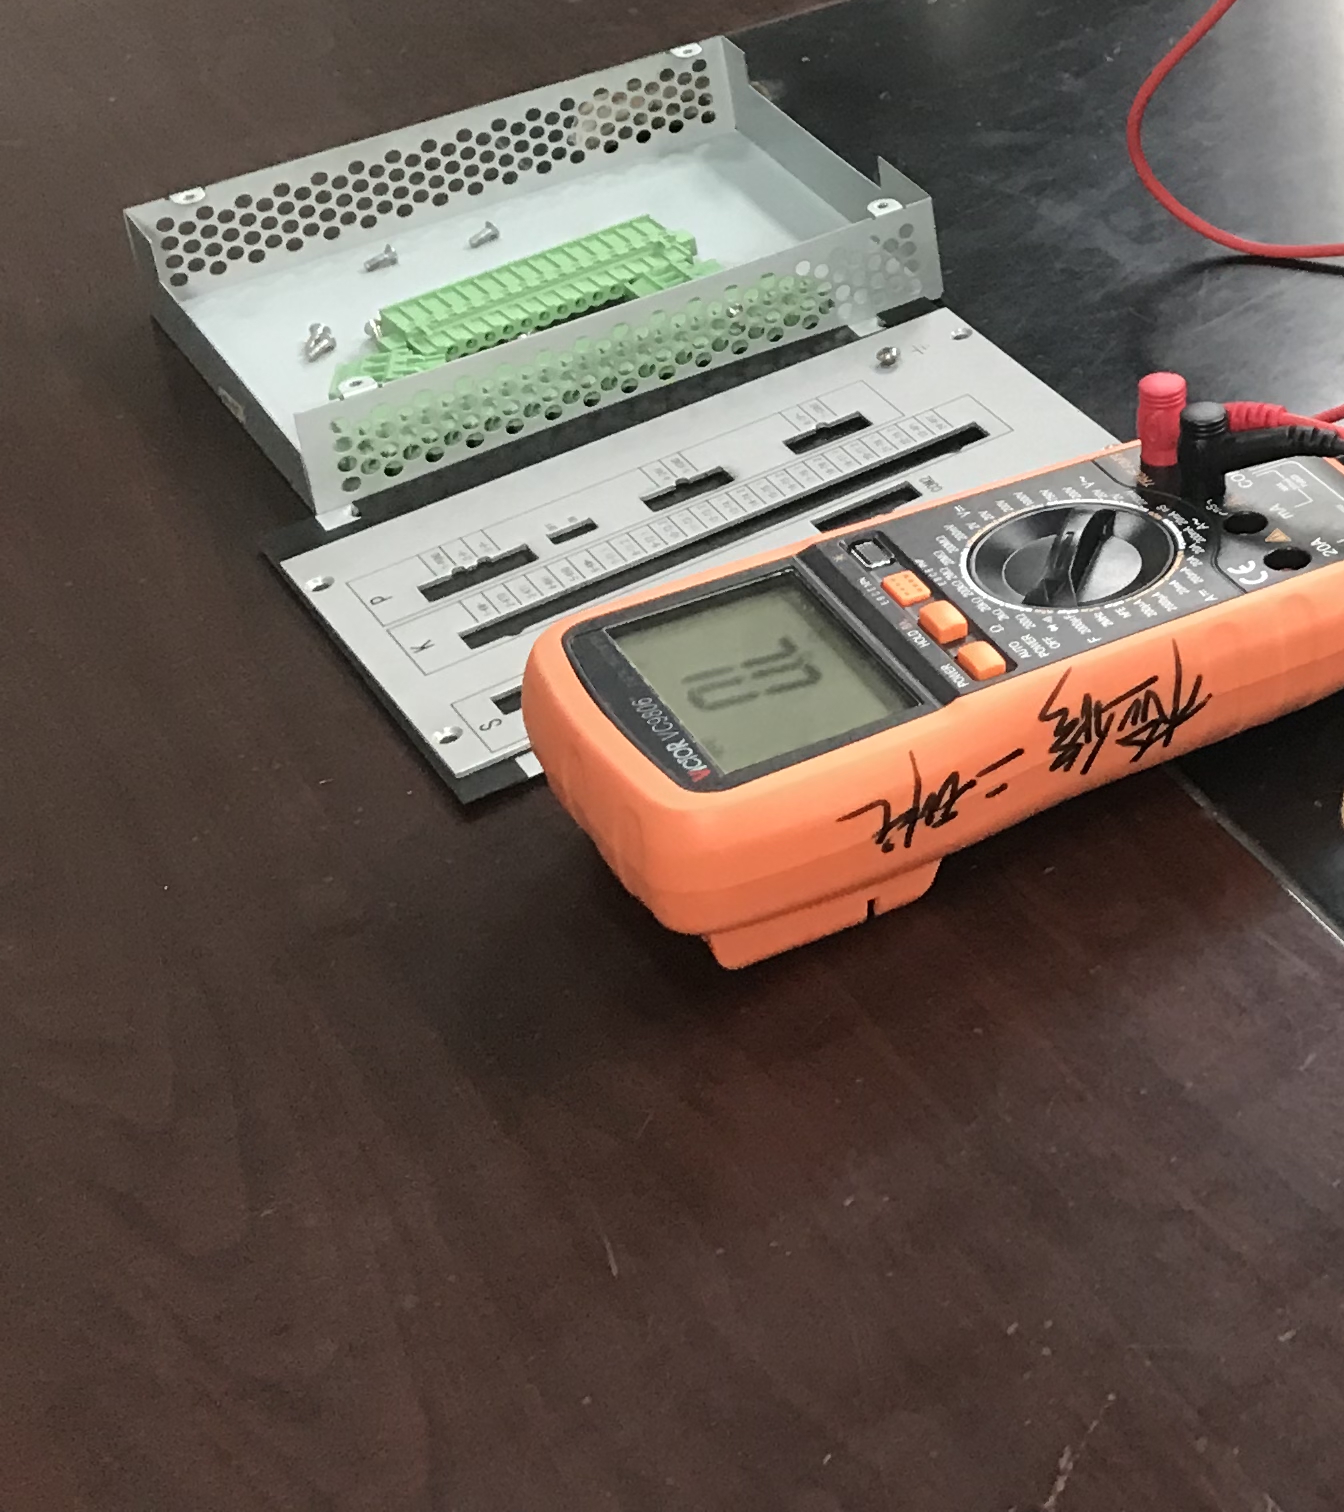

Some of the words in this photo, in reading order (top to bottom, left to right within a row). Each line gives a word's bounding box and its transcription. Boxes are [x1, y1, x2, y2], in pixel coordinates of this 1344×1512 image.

[1269, 502, 1294, 520] mA
[1310, 536, 1338, 558] 20A
[410, 638, 435, 655] K
[907, 629, 931, 648] HOLD
[1020, 633, 1050, 658] POWER
[1042, 636, 1061, 650] OFF
[1008, 640, 1032, 659] AUTO
[940, 663, 970, 689] POWER
[479, 717, 503, 733] S
[665, 737, 712, 783] VICTOR
